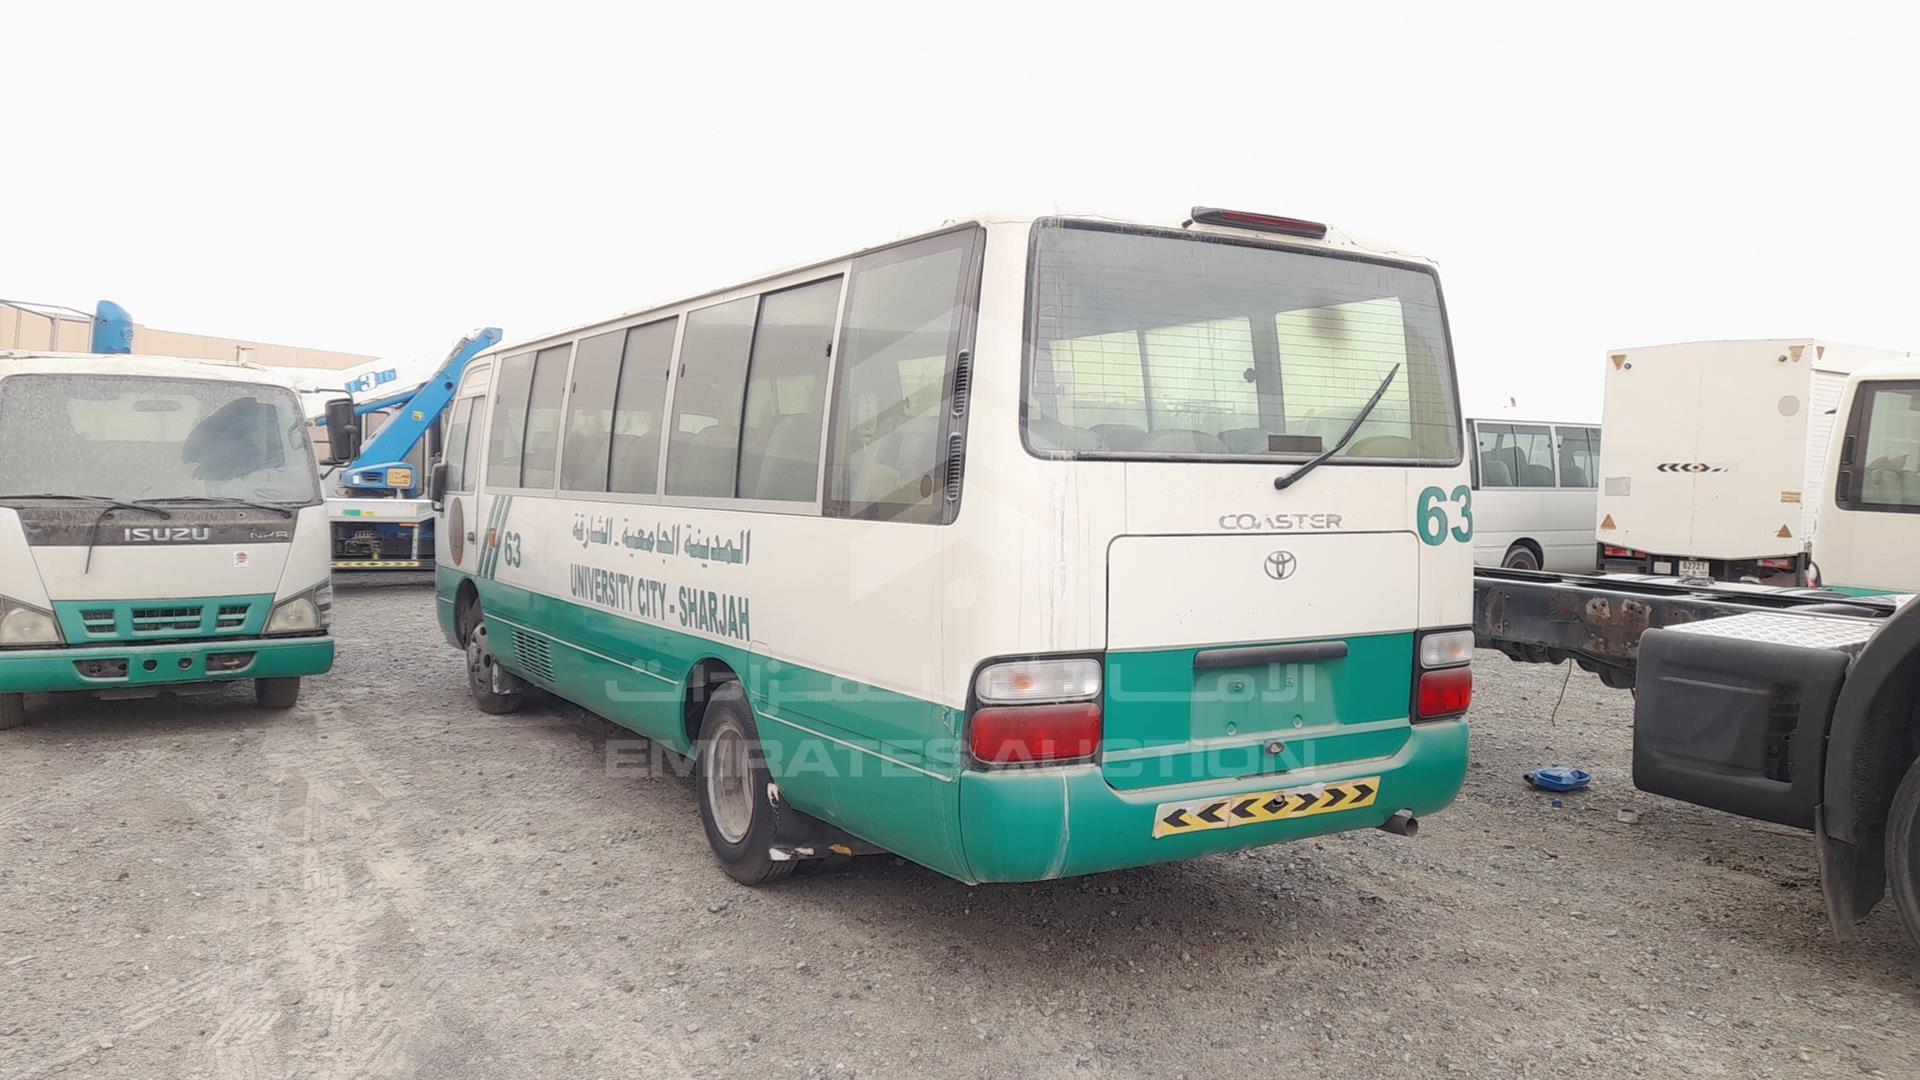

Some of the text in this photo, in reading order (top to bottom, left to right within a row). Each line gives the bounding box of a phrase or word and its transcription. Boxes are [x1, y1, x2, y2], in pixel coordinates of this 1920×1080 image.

[124, 527, 210, 542] ISUZU
[572, 512, 614, 549] الشارقة
[1218, 513, 1343, 530] COASTER
[1416, 484, 1474, 547] 63
[504, 530, 522, 569] 63
[621, 517, 681, 565] الجامعية
[684, 523, 752, 568] المدينة
[570, 562, 634, 613] UNIVERSITY
[636, 576, 667, 622] CITY
[678, 585, 751, 642] SHARJAH
